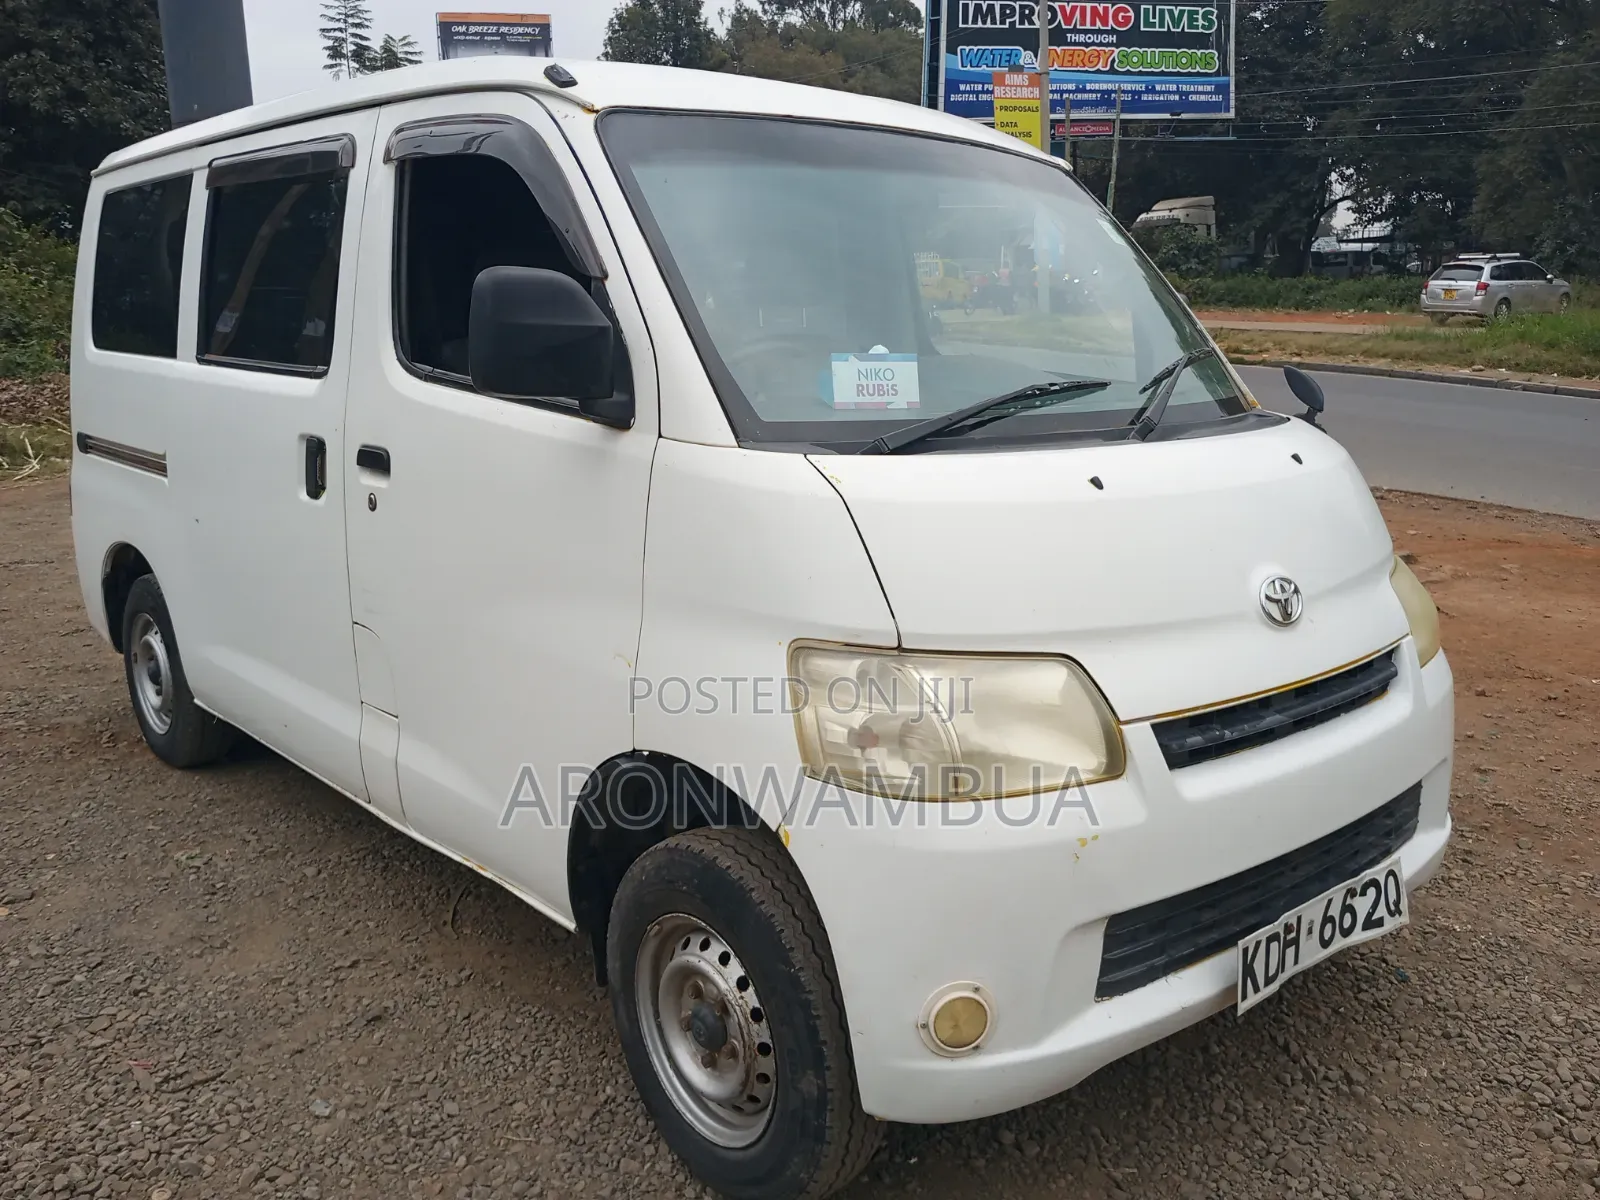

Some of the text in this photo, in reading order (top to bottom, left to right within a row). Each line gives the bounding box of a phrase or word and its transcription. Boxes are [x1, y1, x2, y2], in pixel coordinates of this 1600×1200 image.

[959, 1, 1217, 33] IMPROVING LIVES
[468, 25, 498, 34] BREEZE
[499, 26, 541, 35] RESIDENCY
[1067, 34, 1116, 43] THROUGH
[958, 46, 1024, 69] WATER
[1040, 46, 1116, 70] NERGY
[1115, 47, 1219, 73] SOLUTIONS
[1005, 74, 1029, 86] AIMS
[959, 83, 982, 91] WATER
[984, 83, 994, 91] PU
[1155, 84, 1177, 92] WATER
[1179, 84, 1215, 92] TREATMENT
[994, 86, 1039, 99] RESEARCH
[978, 93, 994, 101] ENGI
[1062, 93, 1101, 101] MACHINERY
[1141, 93, 1180, 101] IRRIGATION
[1188, 94, 1223, 102] CHEMICALS
[999, 105, 1040, 113] PROPOSALS
[857, 367, 895, 382] NIKO
[1240, 868, 1403, 1003] KDH 662Q
